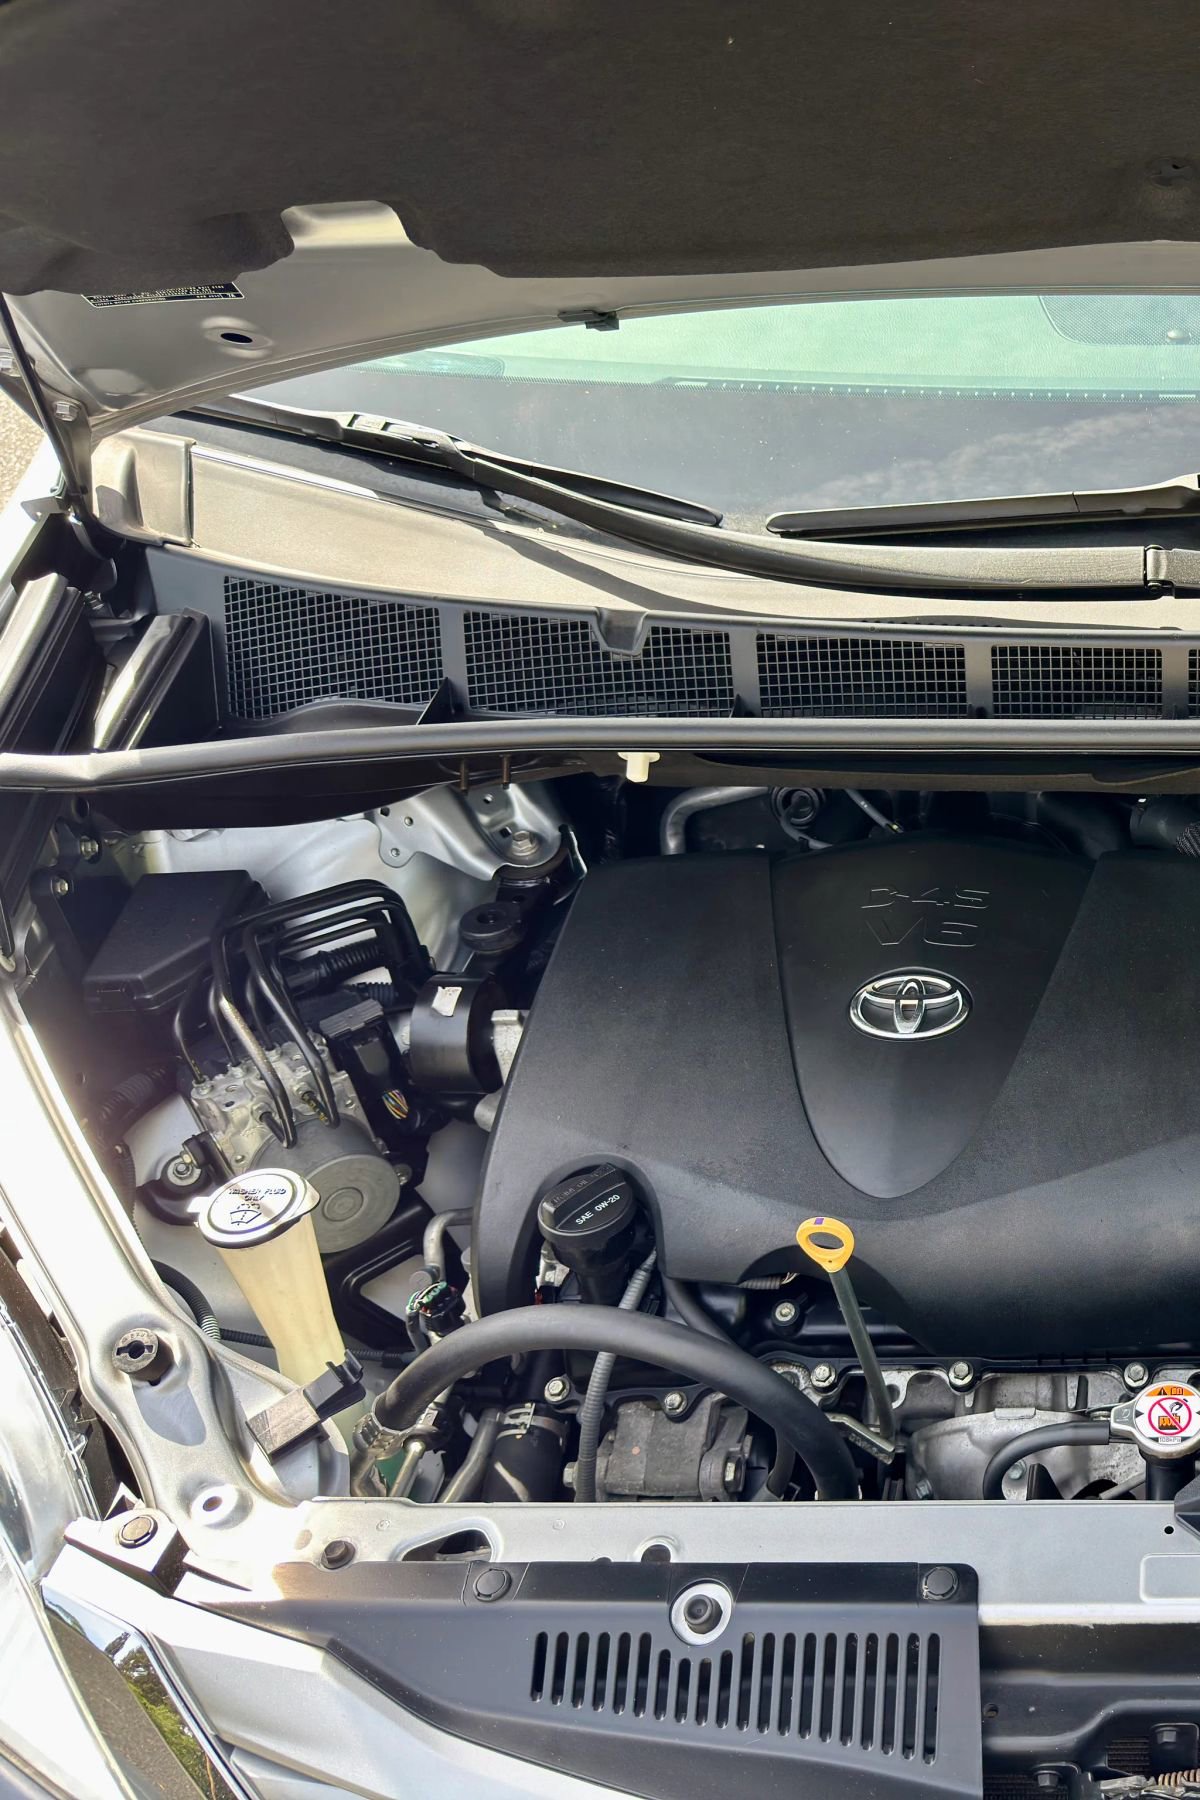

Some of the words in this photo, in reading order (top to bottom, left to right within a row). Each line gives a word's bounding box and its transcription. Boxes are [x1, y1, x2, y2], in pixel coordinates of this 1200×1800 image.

[864, 916, 979, 948] V6
[575, 1211, 594, 1225] SAE
[595, 1194, 620, 1212] 0W-20
